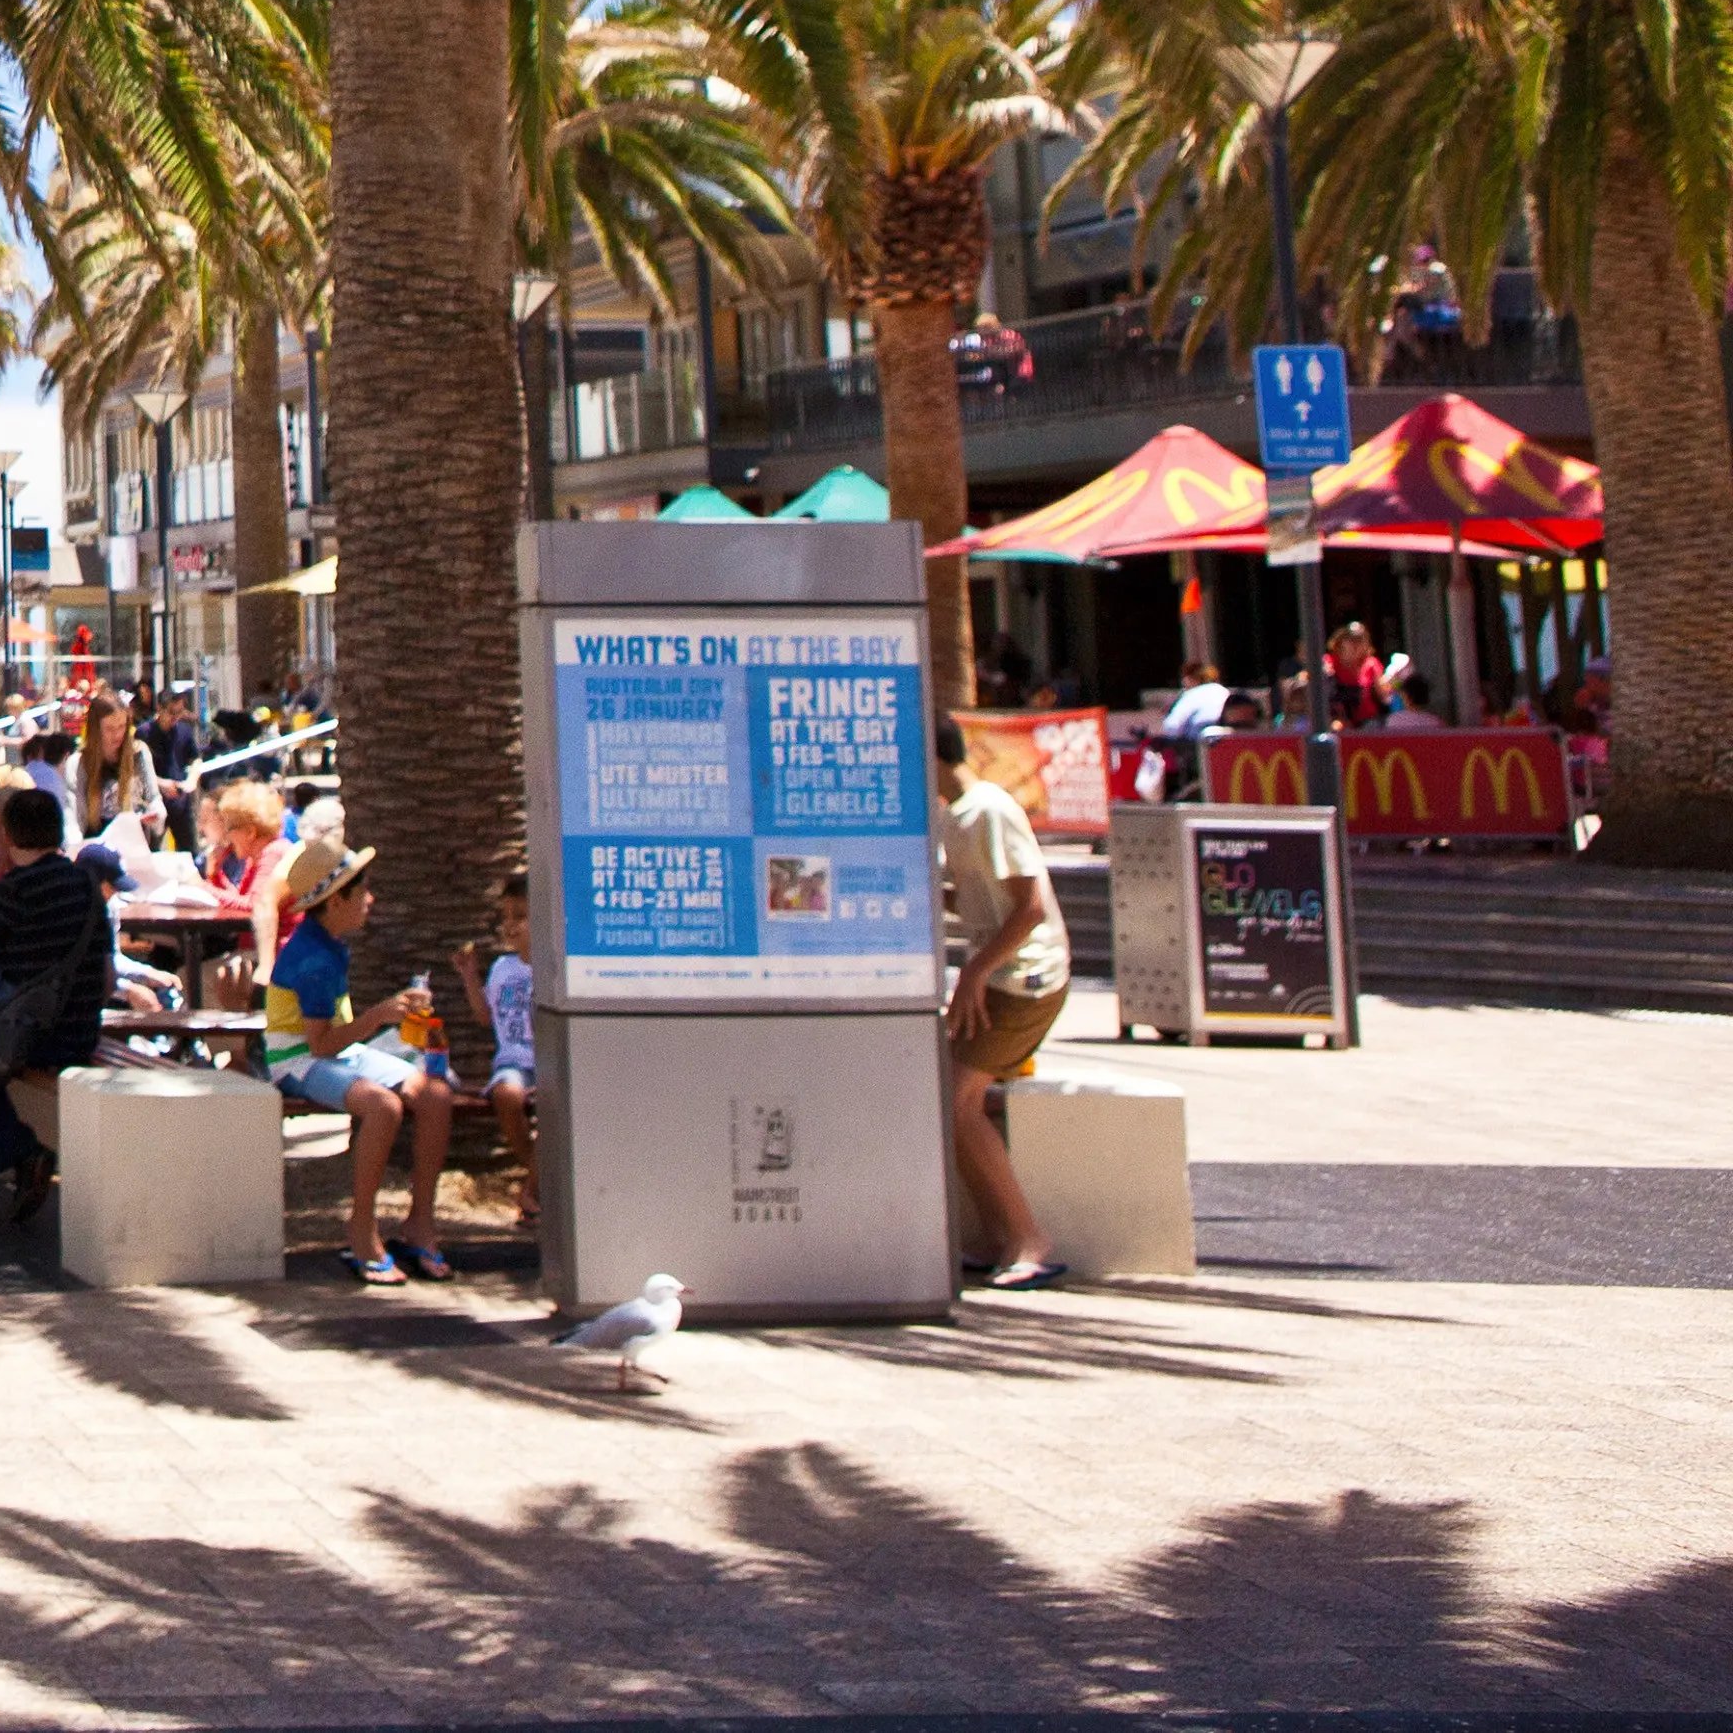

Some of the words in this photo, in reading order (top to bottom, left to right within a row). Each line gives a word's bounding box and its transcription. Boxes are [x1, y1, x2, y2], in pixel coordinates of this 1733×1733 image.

[575, 635, 691, 665] WHAT'S
[700, 635, 738, 665] ON
[748, 635, 781, 665] AT
[790, 635, 840, 665] THE
[849, 635, 902, 665] BAY
[585, 677, 683, 695] AUSTRALIA
[689, 677, 724, 695] DAY
[769, 678, 896, 717] FRINGE
[586, 698, 616, 720] 26
[624, 698, 724, 720] JANUARY
[770, 719, 798, 743] AT
[806, 719, 847, 743] THE
[853, 719, 896, 743] BAY
[859, 745, 899, 765] MAR
[601, 765, 638, 785] UTE
[646, 765, 728, 785] MUSTER
[785, 767, 835, 788] OPEN
[1461, 747, 1548, 819] M
[787, 792, 879, 815] GLENELG
[592, 846, 618, 867] BE
[624, 846, 701, 867] ACTIVE
[593, 870, 615, 888] AT
[623, 870, 658, 888] THE
[663, 870, 701, 888] BAY
[1201, 862, 1256, 889] GLO
[593, 890, 606, 907] 4
[684, 890, 723, 908] MAR
[595, 928, 654, 945] FUSION
